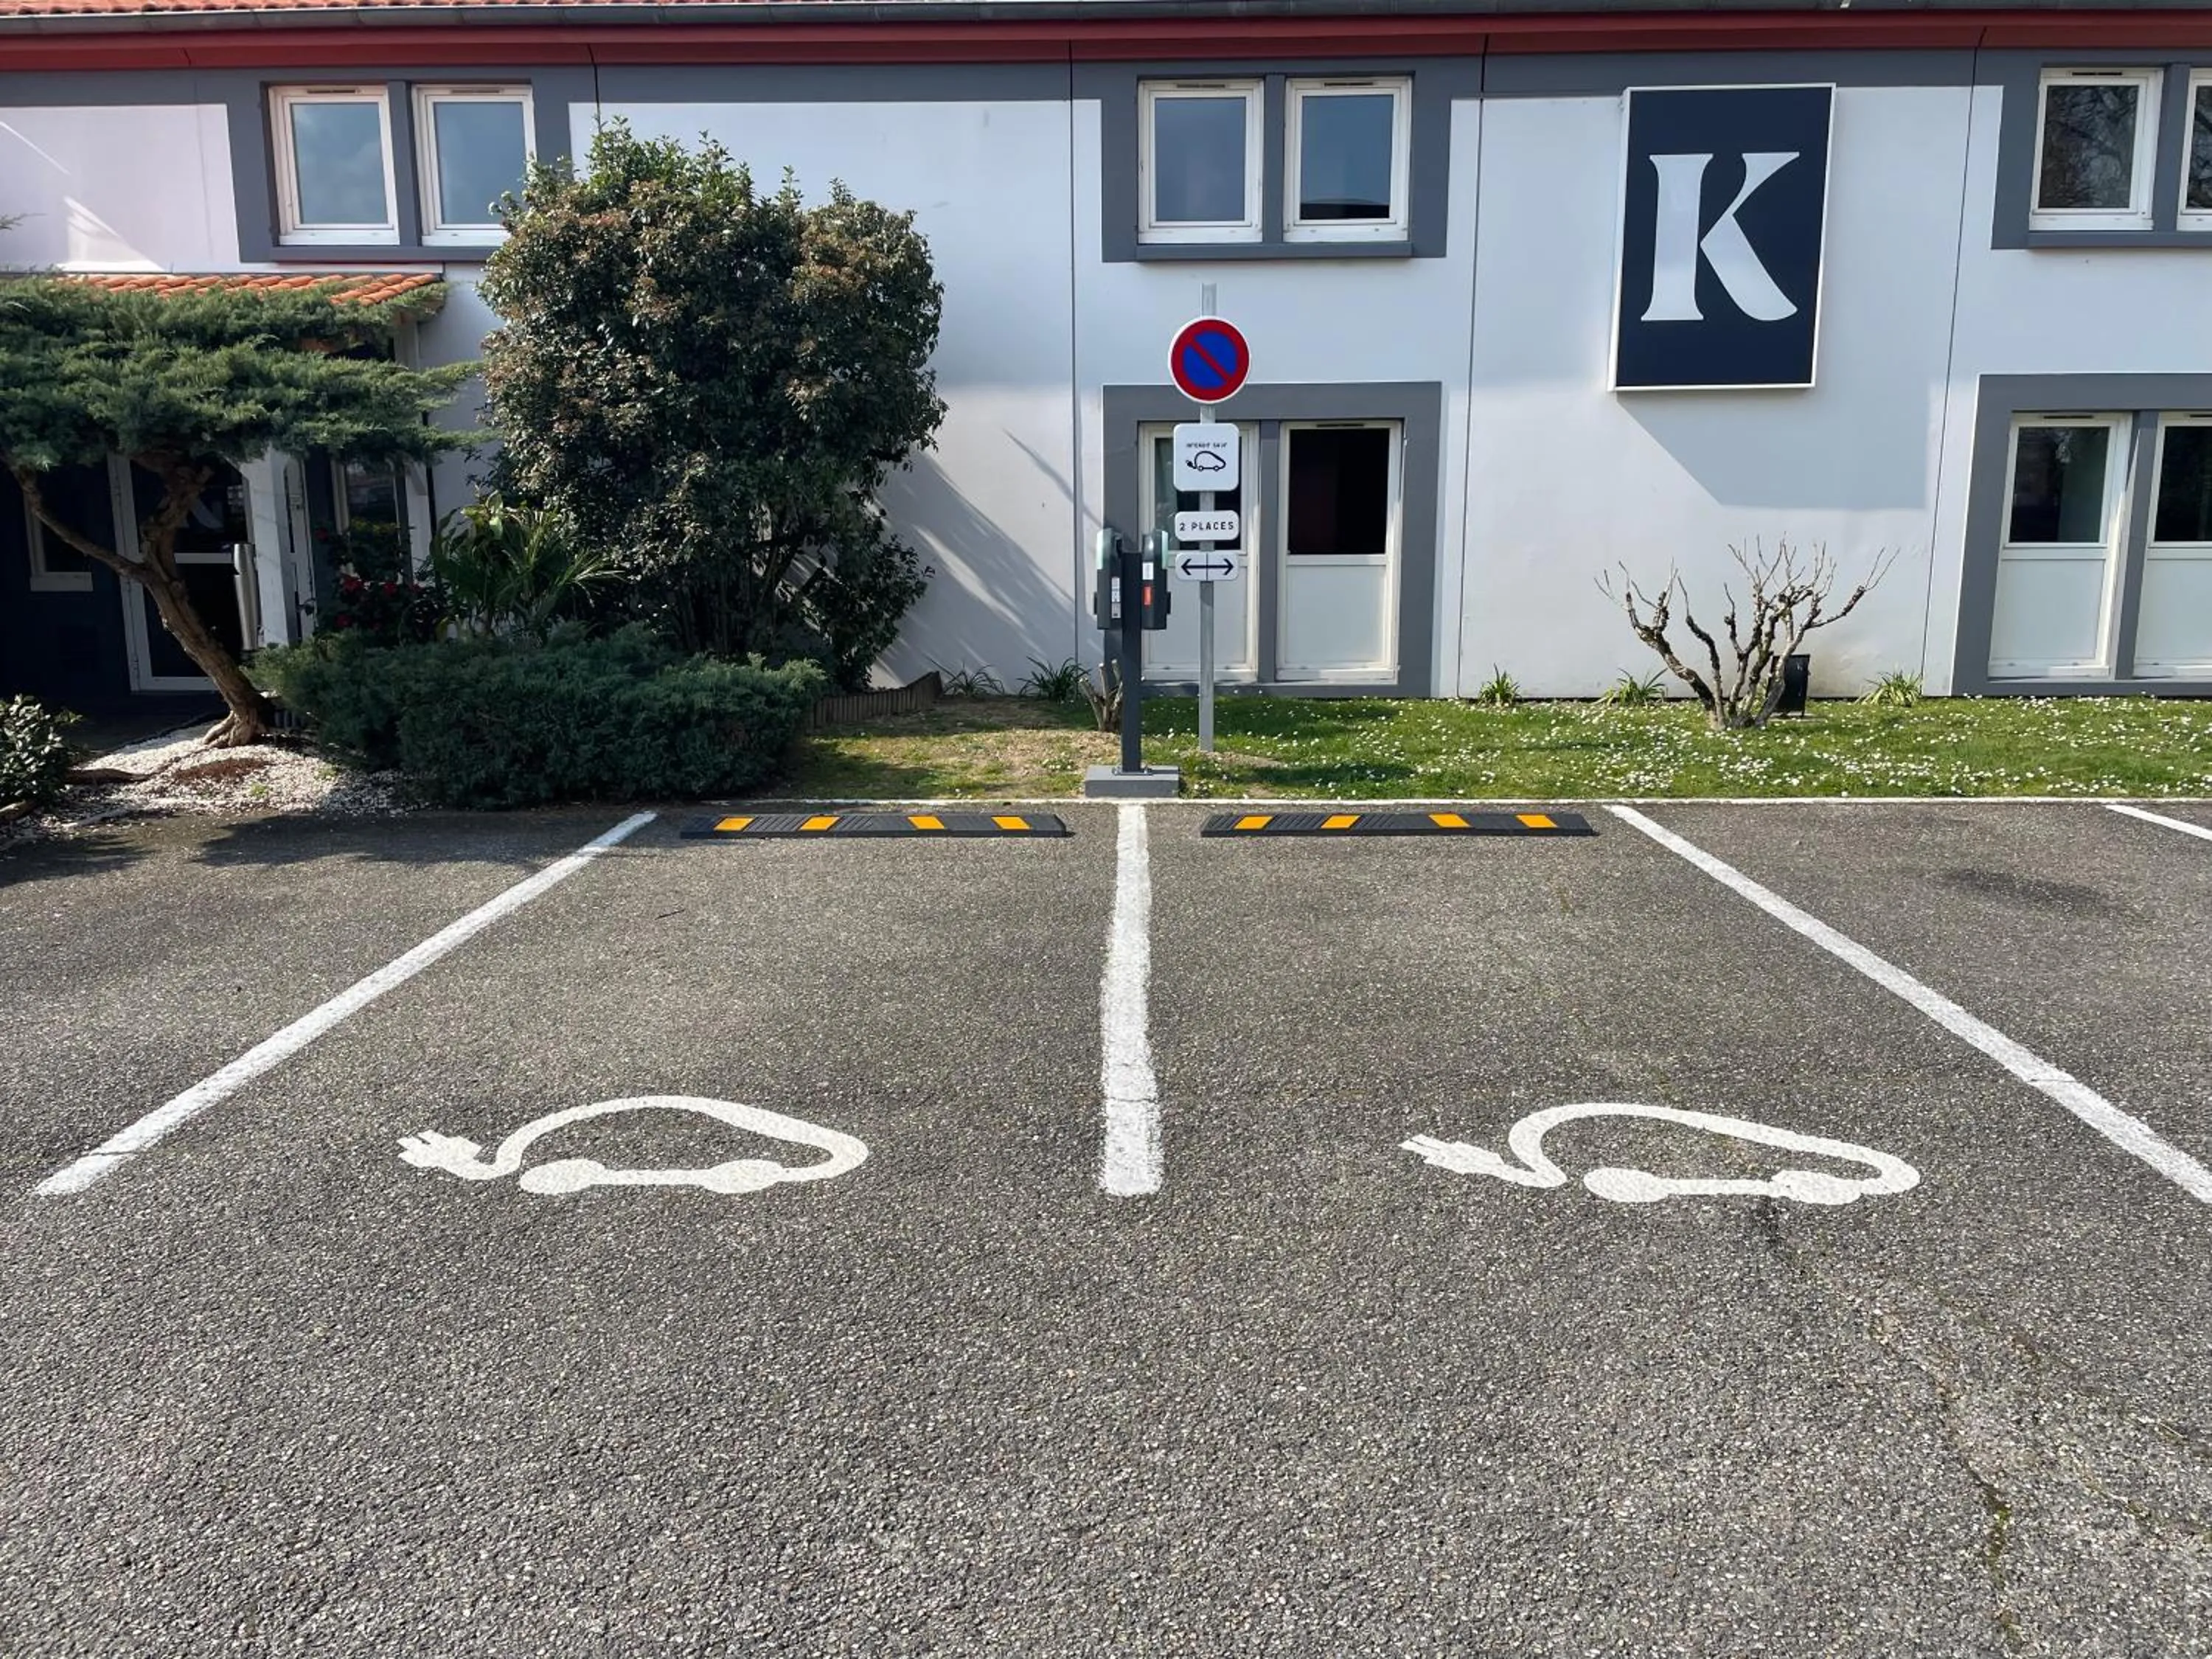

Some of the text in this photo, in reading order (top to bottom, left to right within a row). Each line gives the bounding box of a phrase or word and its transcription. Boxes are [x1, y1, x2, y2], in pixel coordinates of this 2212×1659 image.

[1641, 152, 1800, 321] K
[1179, 521, 1234, 532] 2 PLACES
